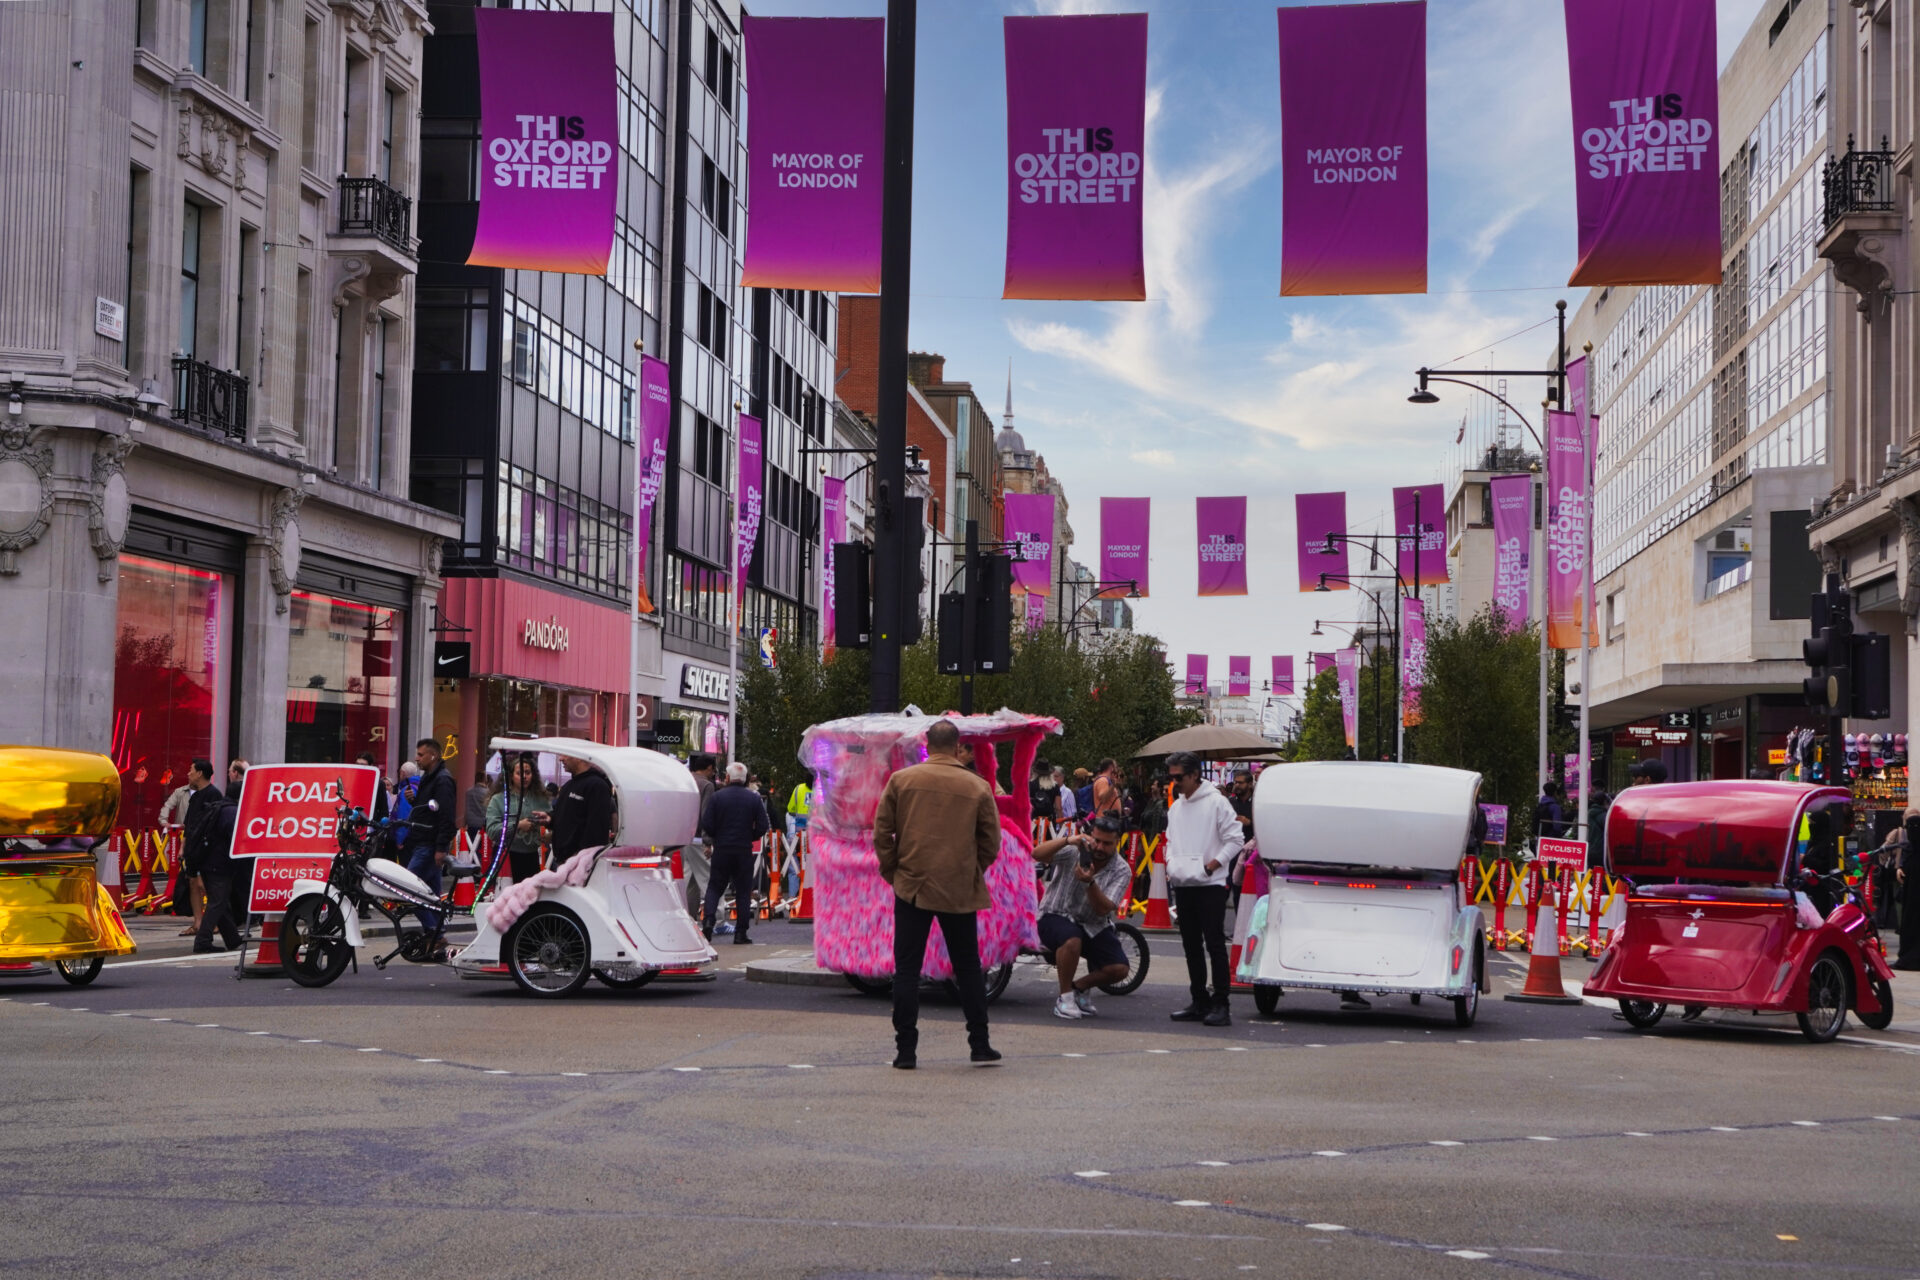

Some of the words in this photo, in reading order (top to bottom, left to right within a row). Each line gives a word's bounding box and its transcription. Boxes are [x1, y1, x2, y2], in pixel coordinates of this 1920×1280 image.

[1609, 93, 1682, 126] THIS
[516, 114, 584, 140] THIS
[1582, 118, 1712, 153] OXFORD
[1042, 128, 1113, 153] THIS
[489, 138, 612, 165] OXFORD
[772, 153, 834, 169] MAYOR
[838, 154, 864, 169] OF
[1306, 148, 1373, 164] MAYOR
[1377, 146, 1403, 162] OF
[1588, 144, 1708, 179] STREET
[1014, 152, 1140, 178] OXFORD
[1313, 166, 1397, 184] LONDON
[494, 163, 606, 189] STREET
[778, 172, 858, 188] LONDON
[1020, 178, 1136, 204] STREET
[100, 312, 114, 326] STREET
[1016, 531, 1040, 542] THIS
[1209, 534, 1235, 544] THIS
[1400, 532, 1444, 543] OXORD
[1557, 486, 1573, 574] OXFORD
[1200, 544, 1244, 552] OXFORD
[1202, 552, 1243, 562] STREET
[524, 616, 568, 652] PANDORA
[684, 666, 744, 701] SKECHE
[268, 782, 341, 802] ROAD
[246, 817, 339, 838] CLOSE
[1542, 844, 1582, 854] CYCLISTS
[260, 868, 324, 879] CYCLISTS
[256, 889, 294, 900] DISMO
